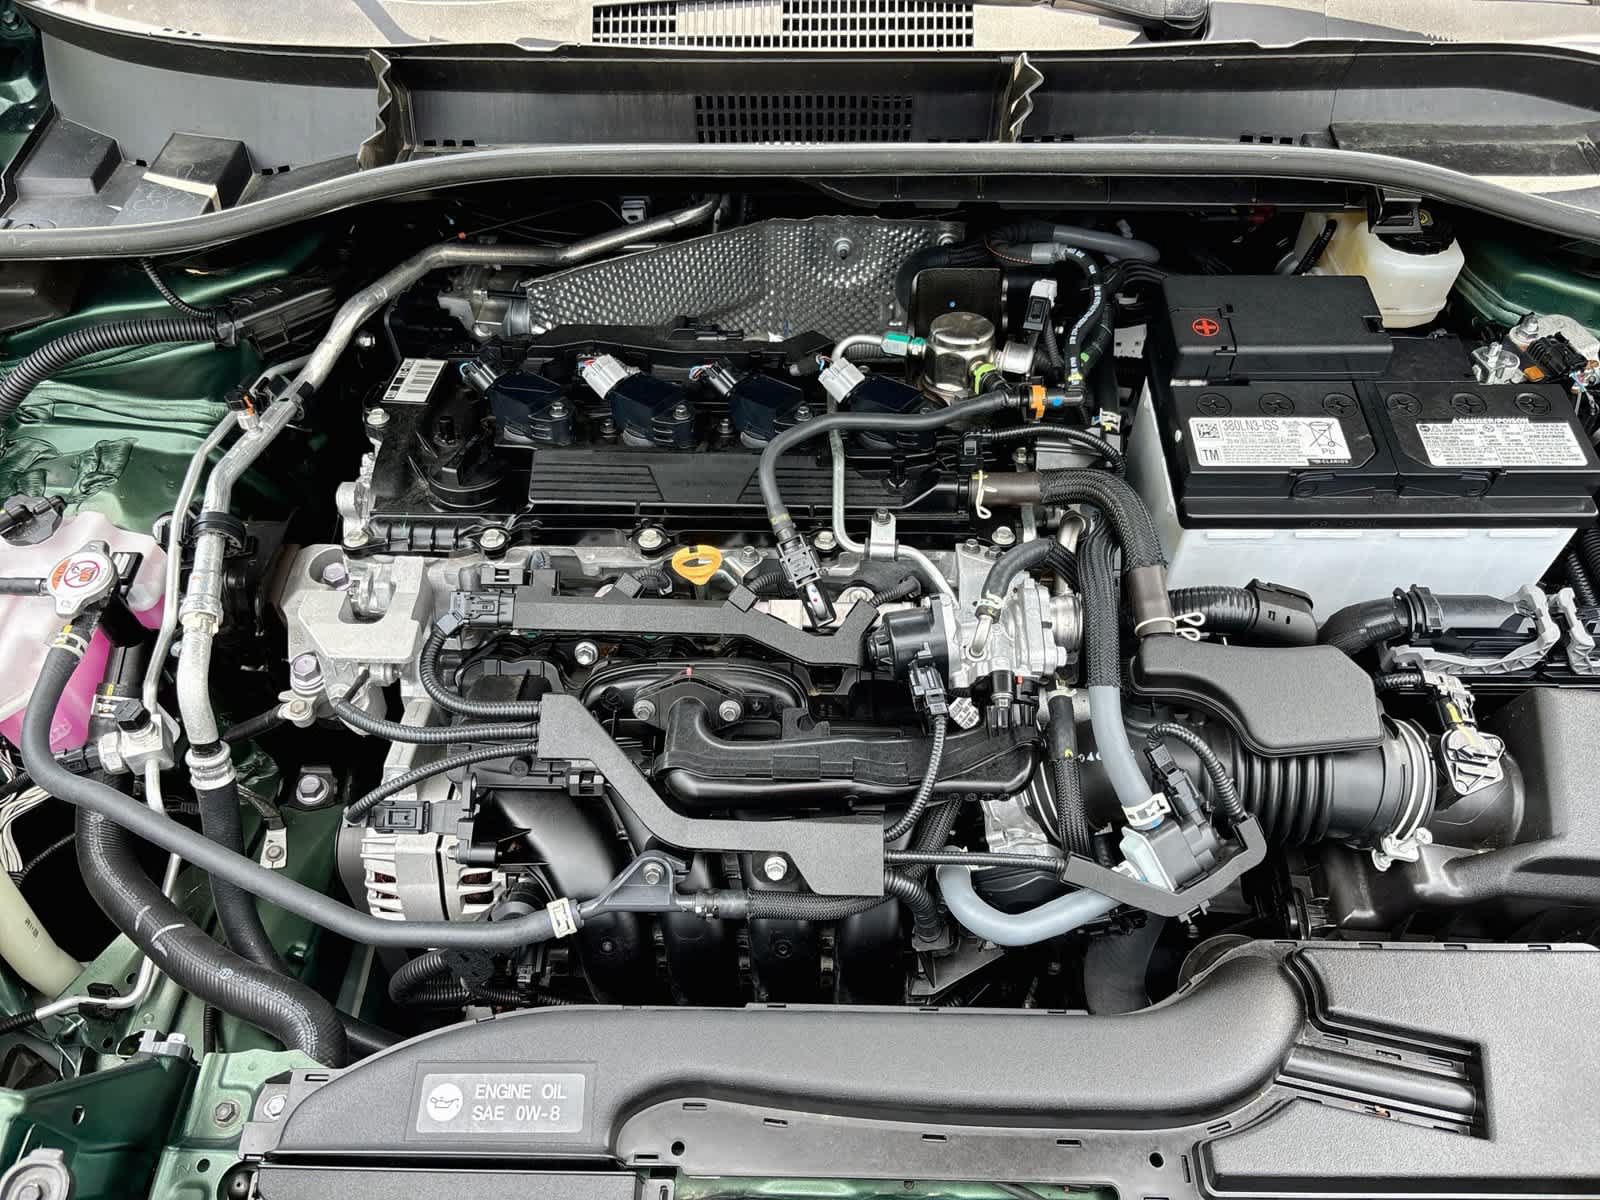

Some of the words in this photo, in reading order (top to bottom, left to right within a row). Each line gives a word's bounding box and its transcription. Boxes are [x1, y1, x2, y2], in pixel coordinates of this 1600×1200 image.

[1221, 420, 1280, 432] 380LN3-ISS
[1201, 449, 1220, 461] TM
[475, 1083, 533, 1099] ENGINE
[542, 1083, 567, 1099] OIL
[471, 1105, 505, 1121] SAE
[516, 1105, 561, 1121] 0W-8
